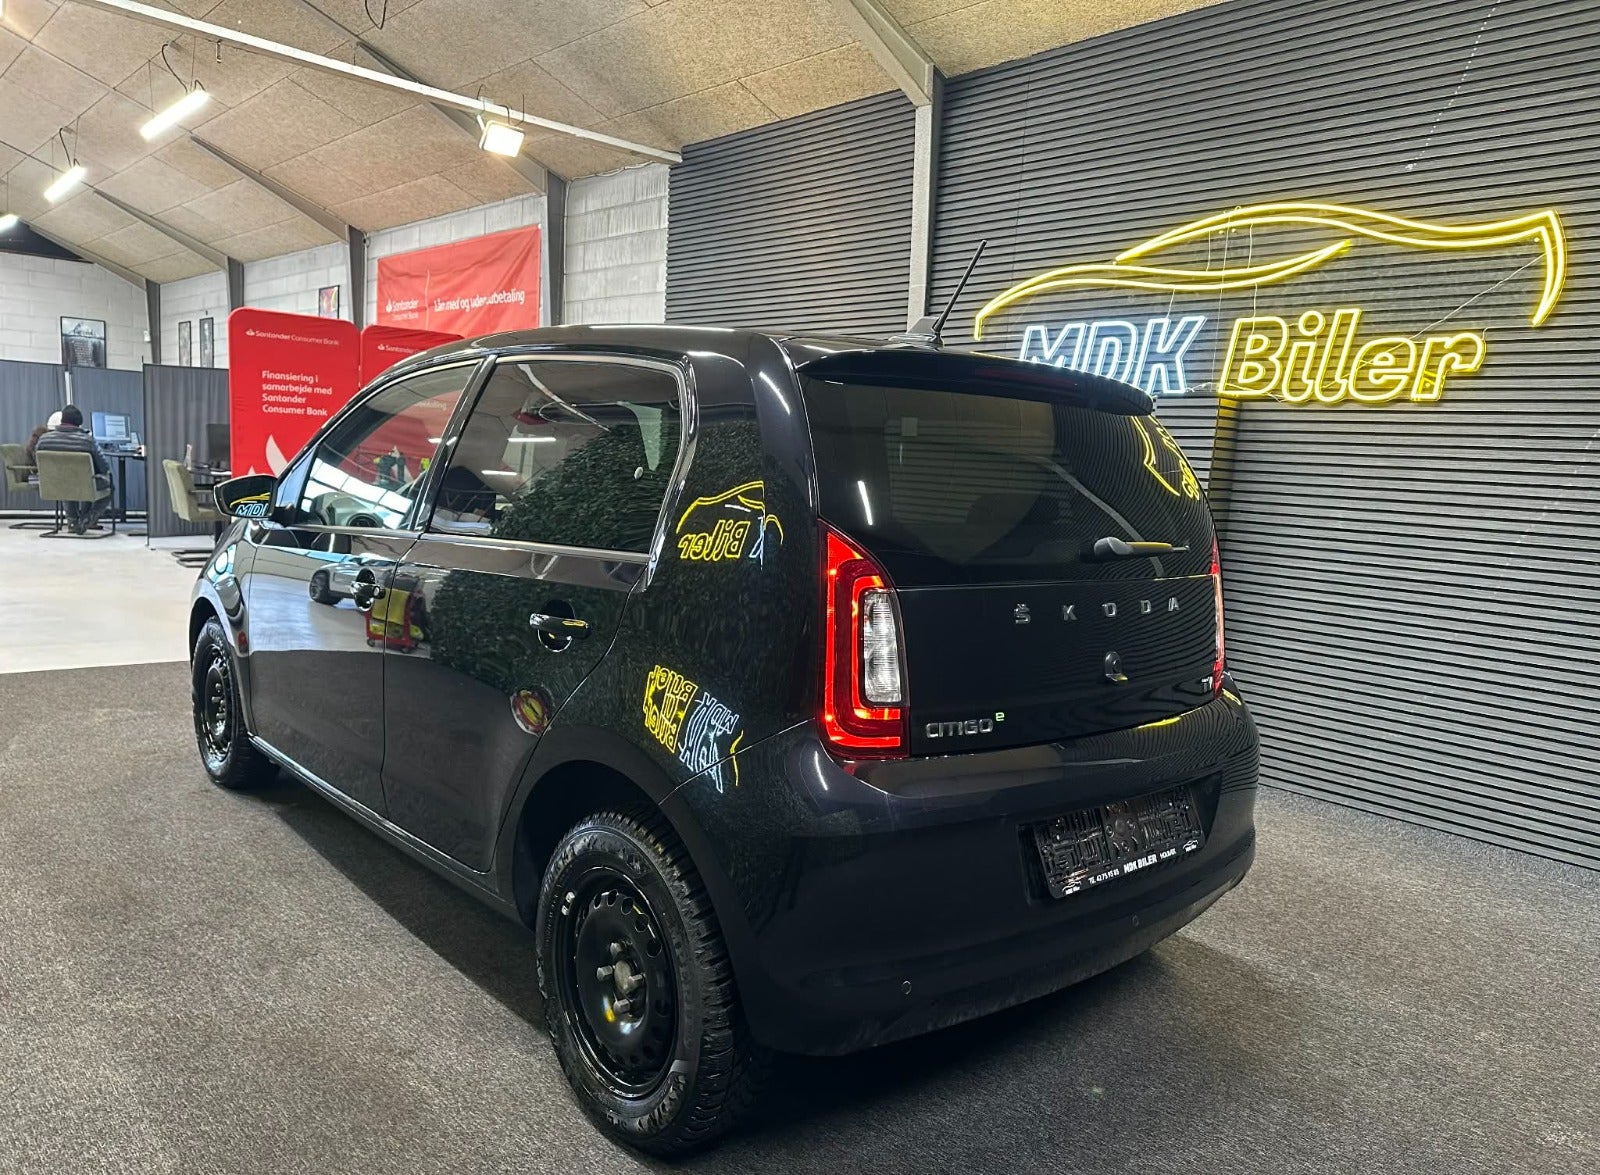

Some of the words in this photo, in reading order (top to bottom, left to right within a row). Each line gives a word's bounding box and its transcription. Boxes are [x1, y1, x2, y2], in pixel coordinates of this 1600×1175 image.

[391, 299, 419, 311] Santander
[460, 298, 470, 312] og
[255, 330, 290, 340] Santander
[291, 334, 322, 345] Consumer
[1019, 315, 1207, 394] MDK
[1217, 308, 1487, 404] Biler
[262, 370, 314, 384] Finansiering
[315, 374, 319, 383] i
[262, 382, 313, 394] samarbejde
[313, 387, 332, 395] med
[262, 393, 306, 403] Santander
[262, 404, 305, 415] Consumer
[306, 407, 328, 416] Bank
[1014, 597, 1180, 624] ŠKODA
[1123, 860, 1138, 874] MDK
[1137, 854, 1158, 869] BILER
